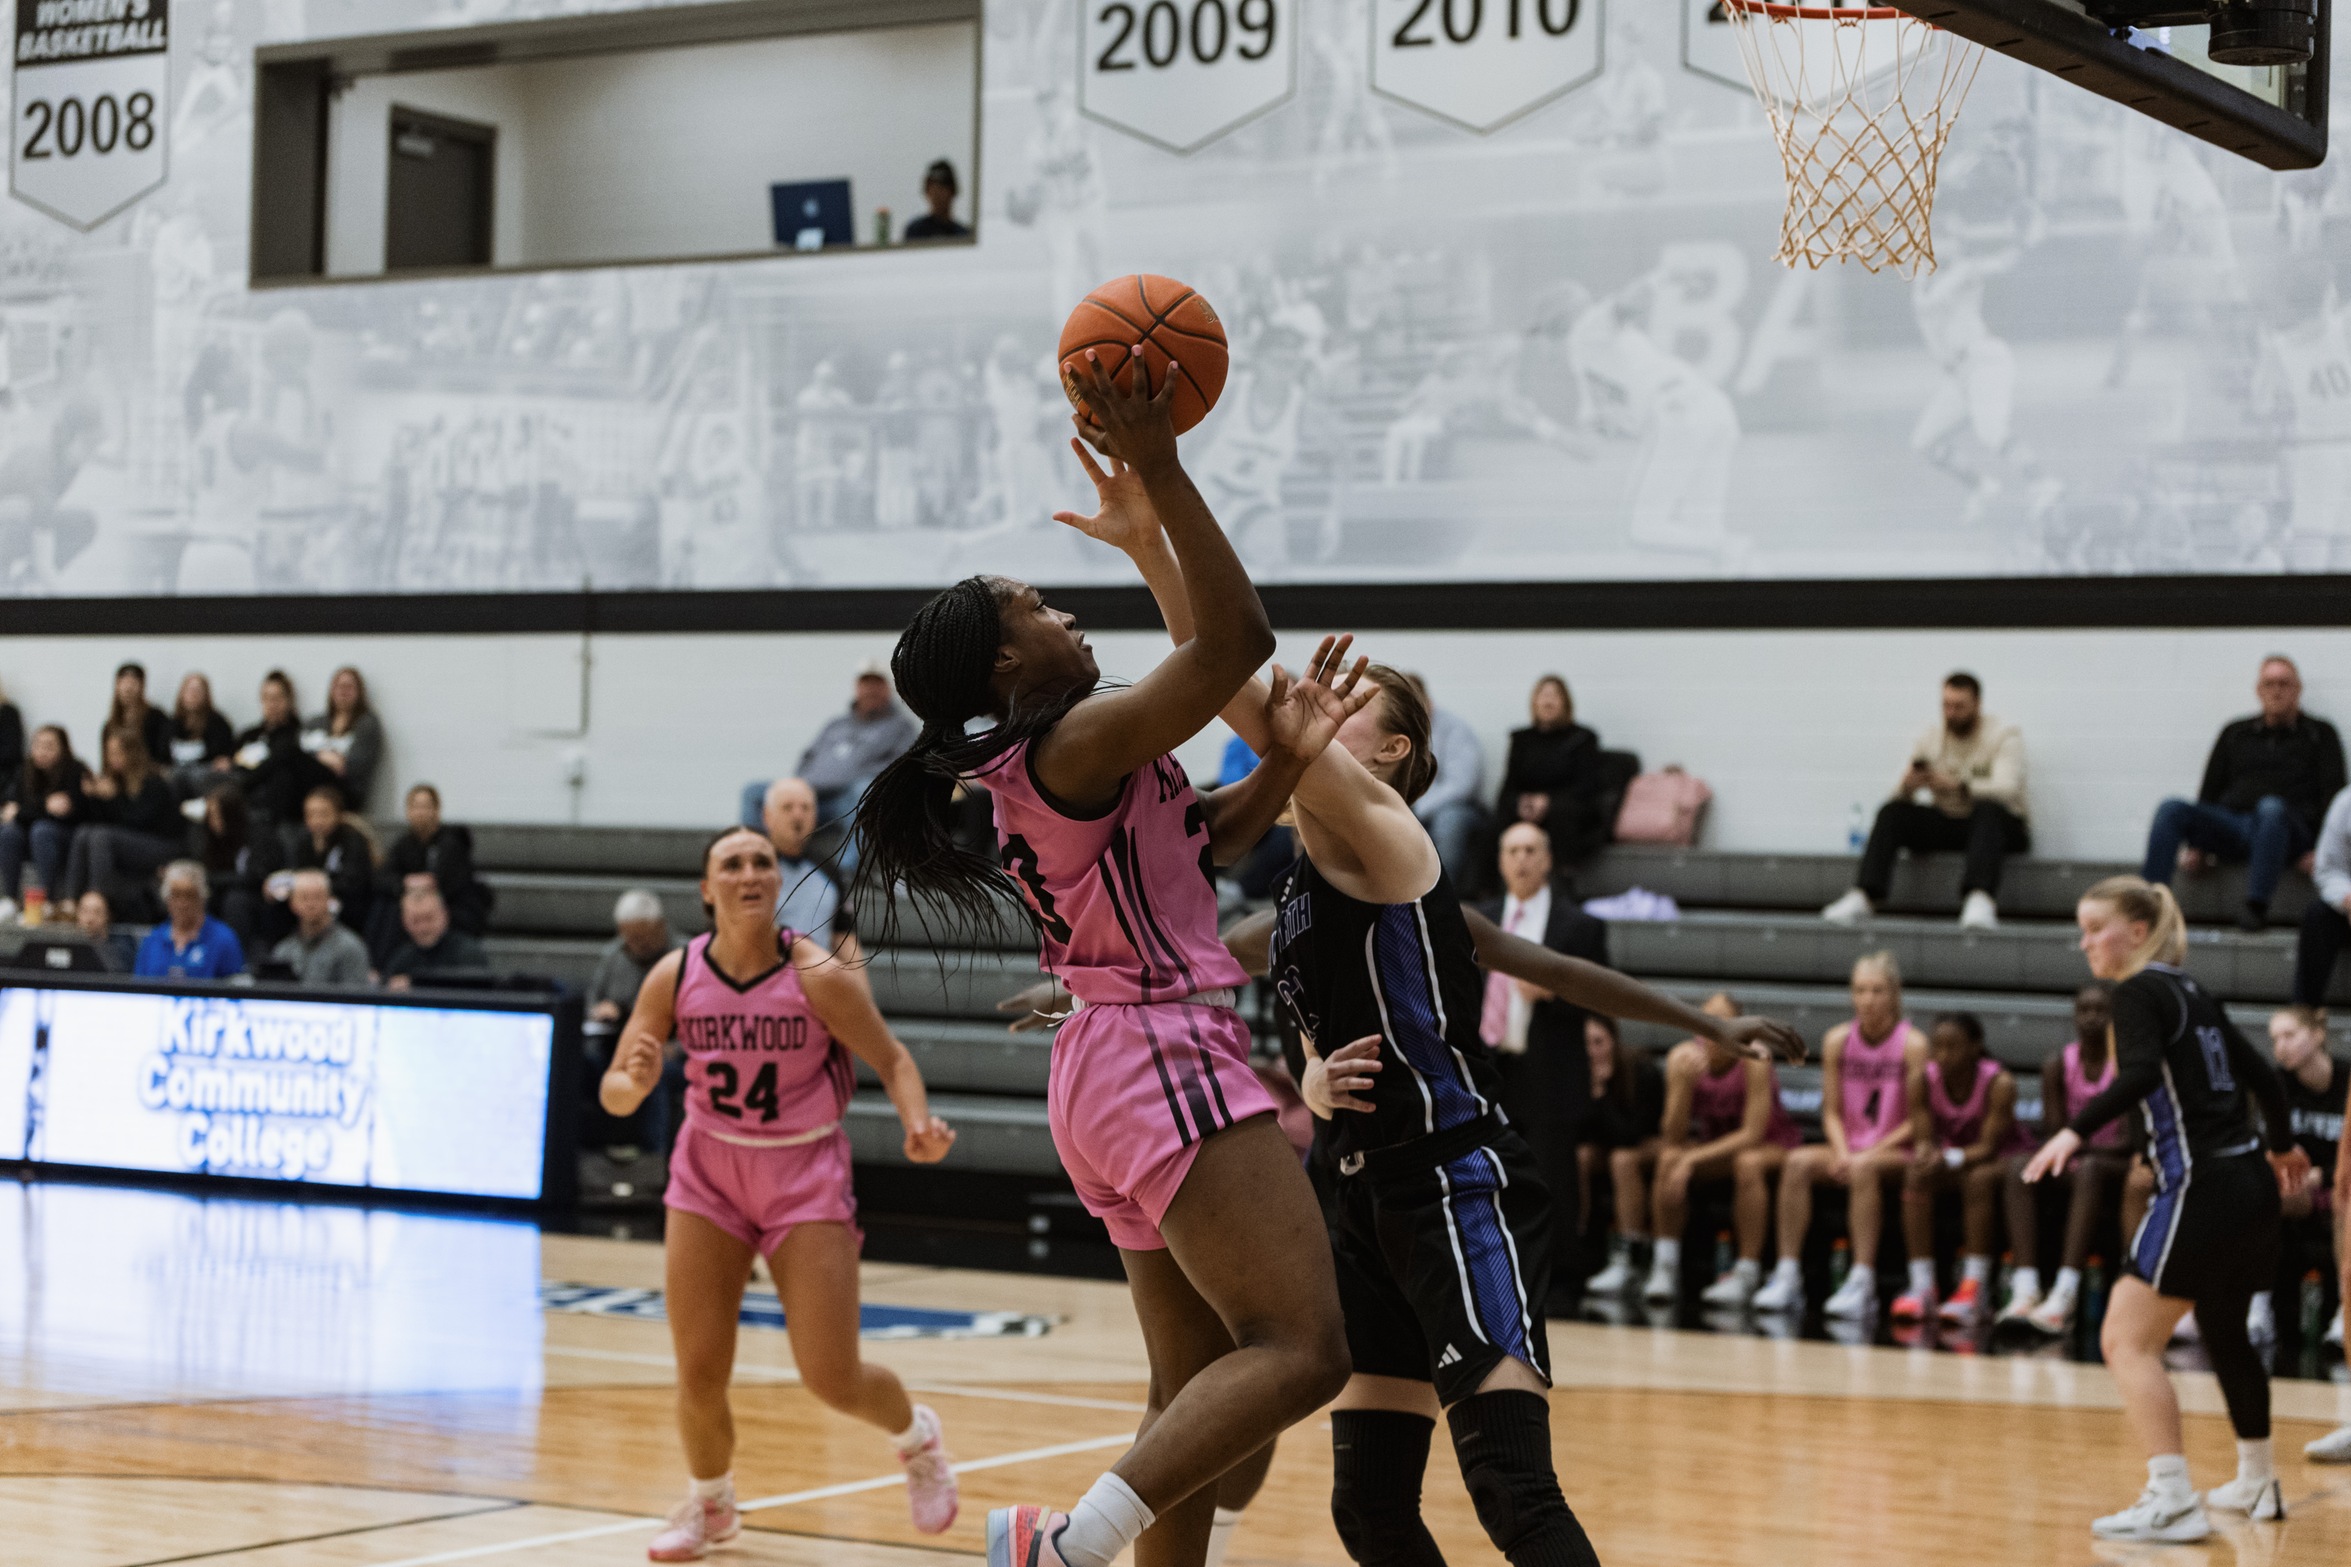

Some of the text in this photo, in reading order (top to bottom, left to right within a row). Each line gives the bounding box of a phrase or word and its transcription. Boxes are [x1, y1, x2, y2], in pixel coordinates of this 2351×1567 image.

[16, 17, 169, 61] BASKETBALL
[1096, 0, 1276, 71] 2009
[23, 91, 155, 160] 2008
[162, 997, 353, 1066] Kirkwood
[140, 1053, 369, 1129] Community
[706, 1061, 779, 1124] 24
[180, 1112, 332, 1179] College
